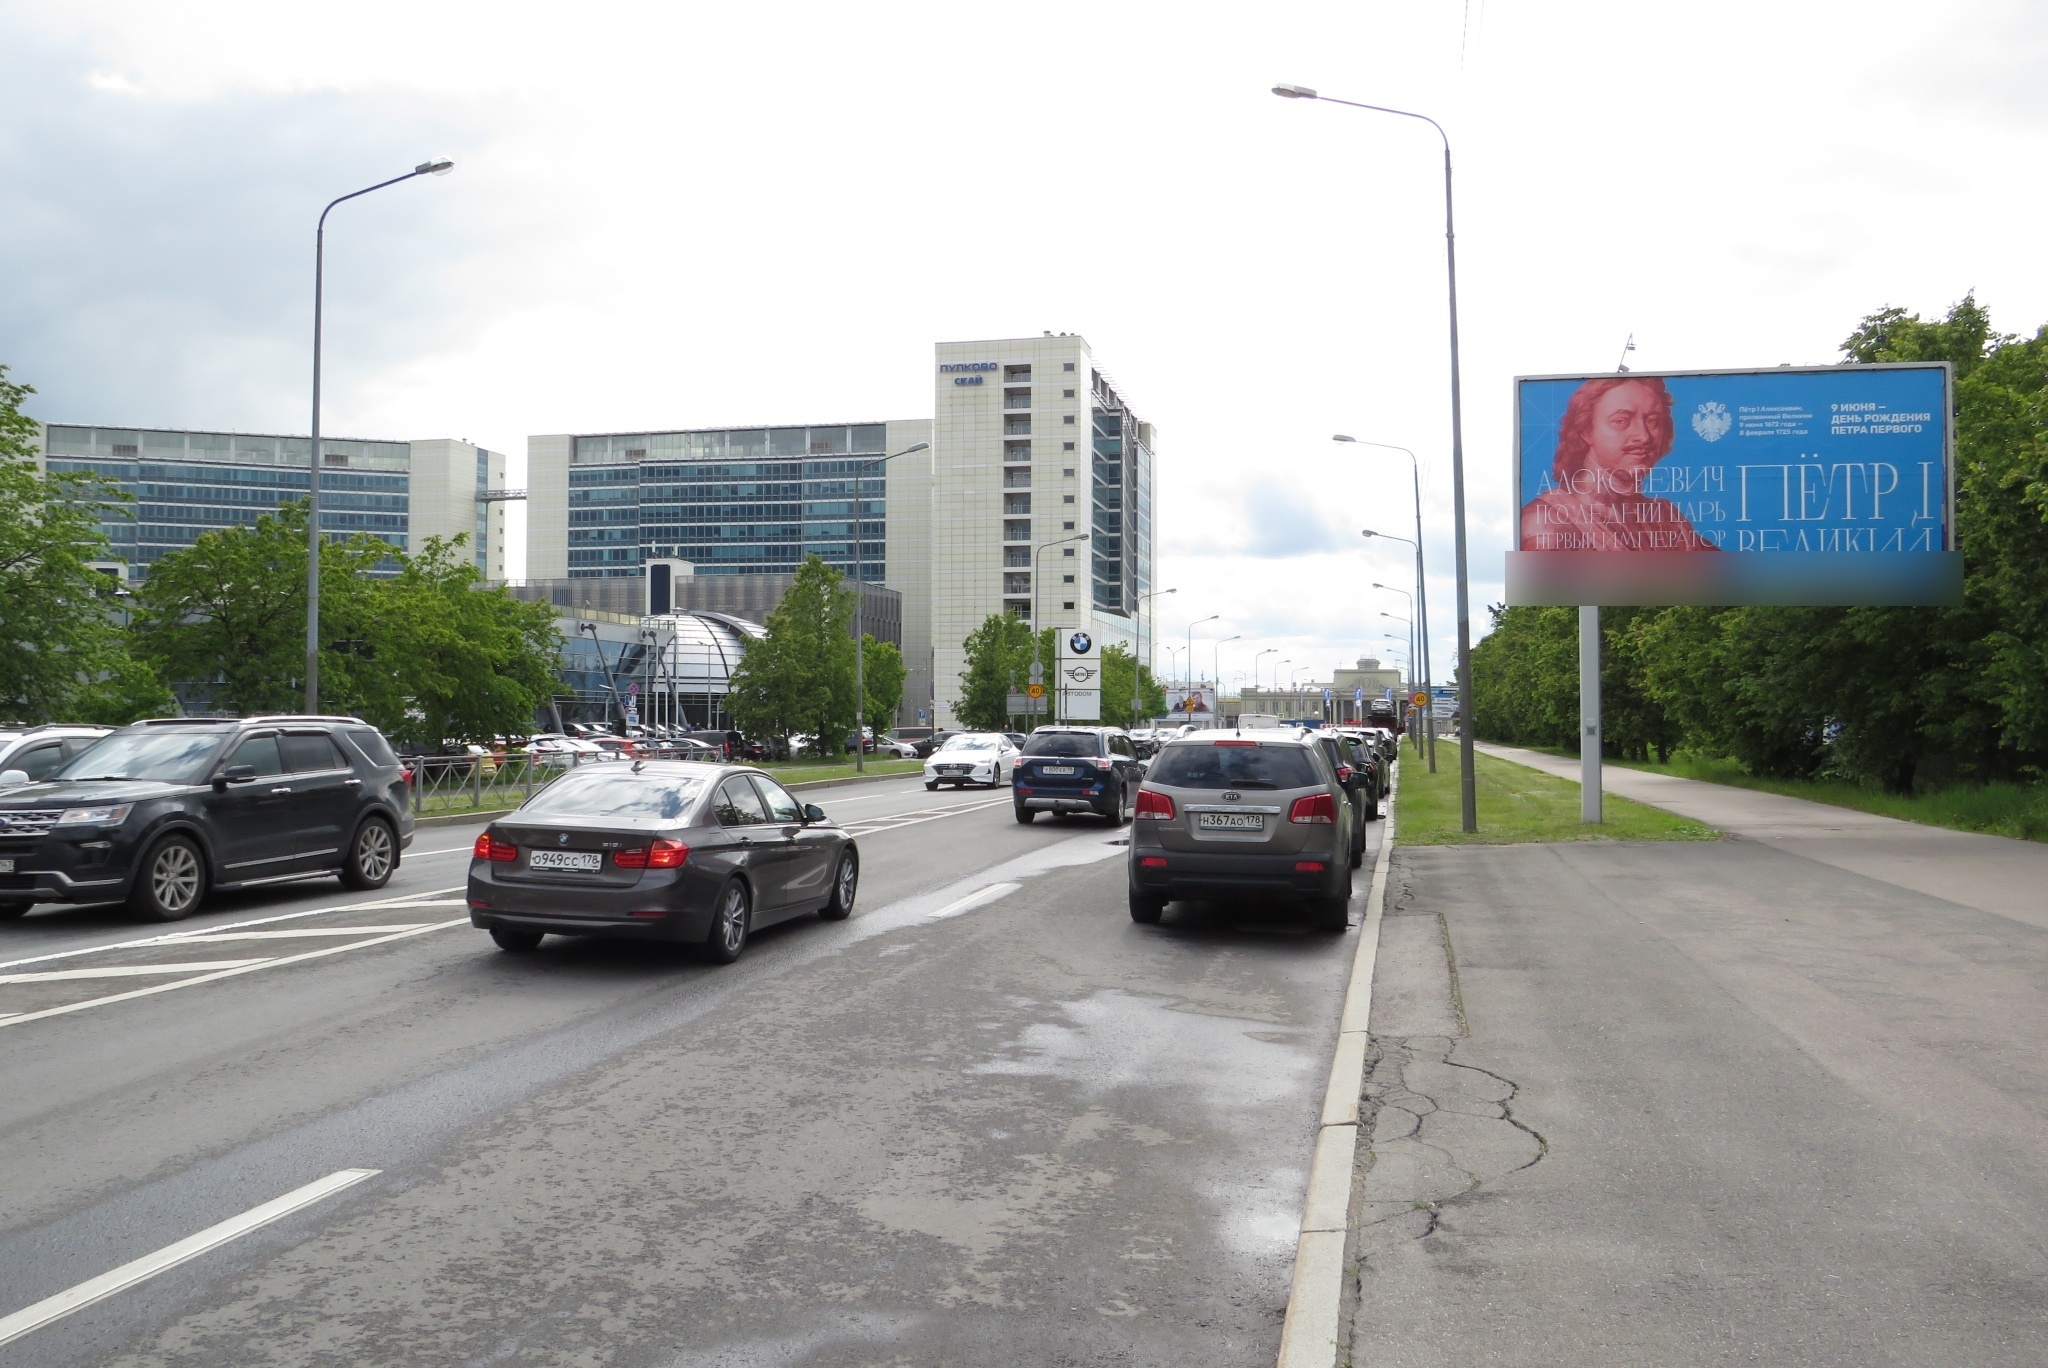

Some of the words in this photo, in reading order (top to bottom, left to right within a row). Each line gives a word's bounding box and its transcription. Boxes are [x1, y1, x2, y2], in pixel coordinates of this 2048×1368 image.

[940, 362, 998, 373] ПУЛКОВО
[954, 375, 983, 385] СКАЙ
[1830, 403, 1838, 412] 9
[1840, 402, 1876, 412] ИЮНЯ
[1831, 414, 1862, 424] ДЕНЬ
[1864, 412, 1931, 424] РОЖДЕНИЯ
[1831, 425, 1868, 435] ПЕТРА
[1870, 424, 1922, 434] ПЕРВОГО
[1535, 465, 1726, 496] АЛЕКСЕЕВИЧ
[1735, 453, 1898, 522] ПЁТР
[1916, 461, 1934, 519] I
[1669, 501, 1726, 526] ЦАРЬ
[1535, 526, 1597, 550] ПЕРВЫЙ
[1601, 529, 1726, 549] ИМПЕРАТОР
[1202, 814, 1244, 826] Н367АО
[1245, 815, 1260, 824] 178
[534, 852, 578, 867] О949СС
[581, 854, 598, 864] 178
